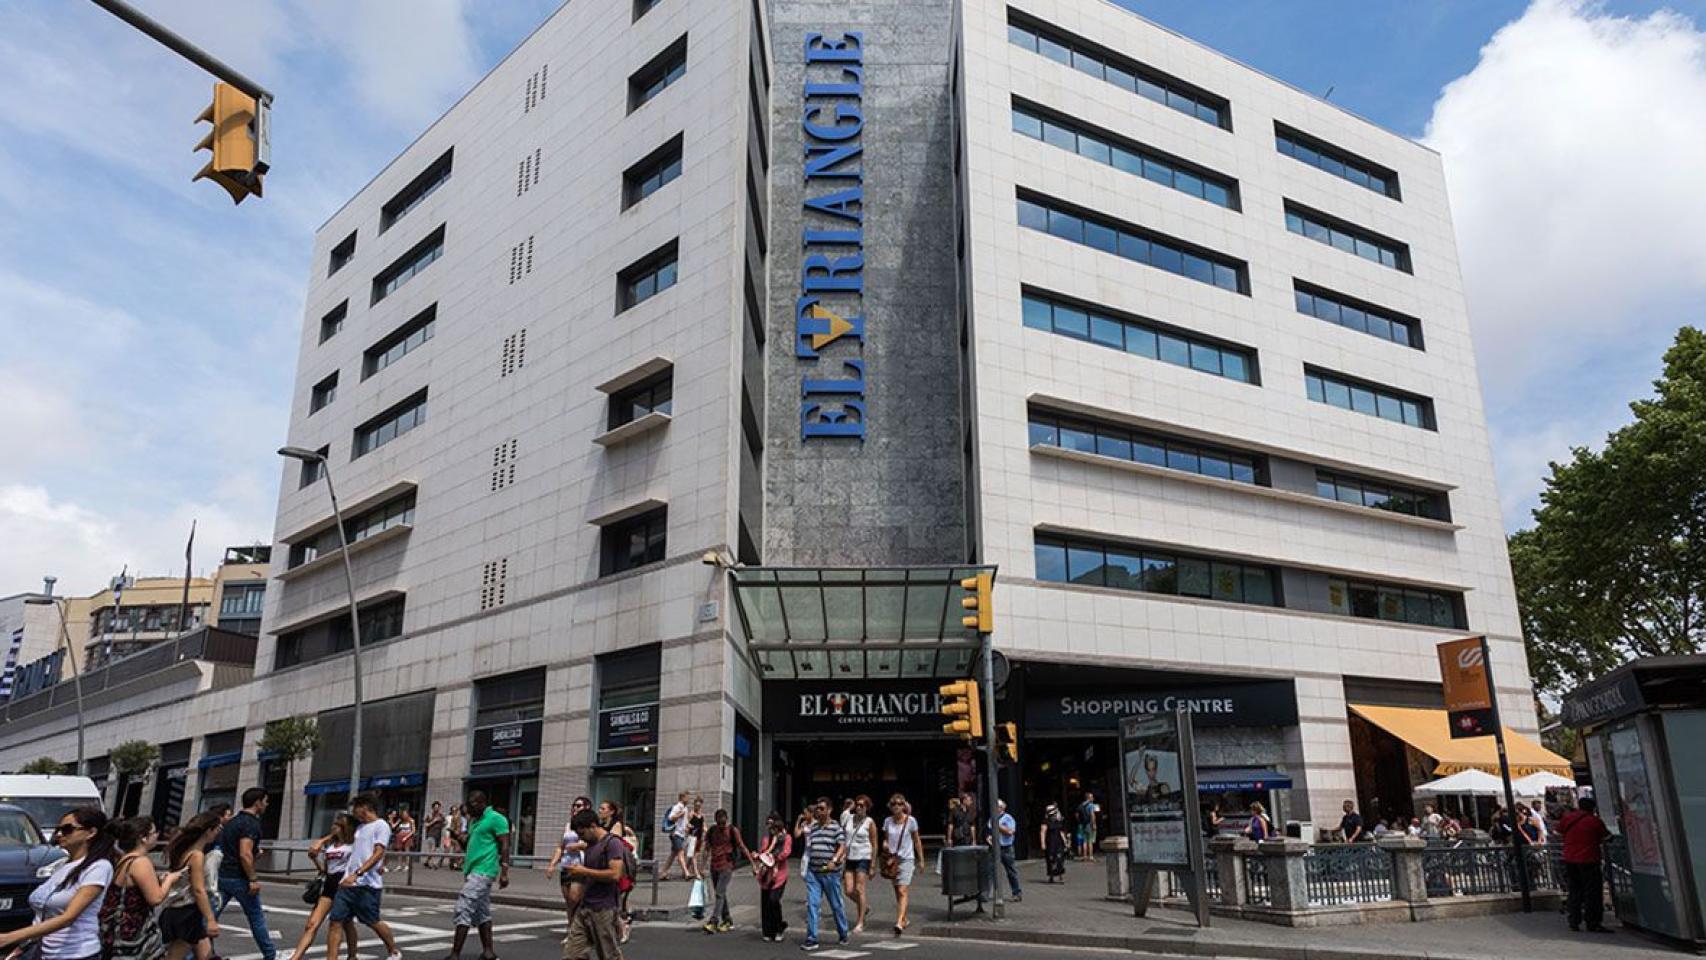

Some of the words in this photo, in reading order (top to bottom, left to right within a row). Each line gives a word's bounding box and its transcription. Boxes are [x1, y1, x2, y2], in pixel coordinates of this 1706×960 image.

[796, 32, 864, 359] TRIANGLE
[803, 358, 866, 441] EL
[800, 694, 828, 716] EL
[1061, 697, 1158, 714] SHOPPING
[1163, 696, 1234, 714] CENTRE
